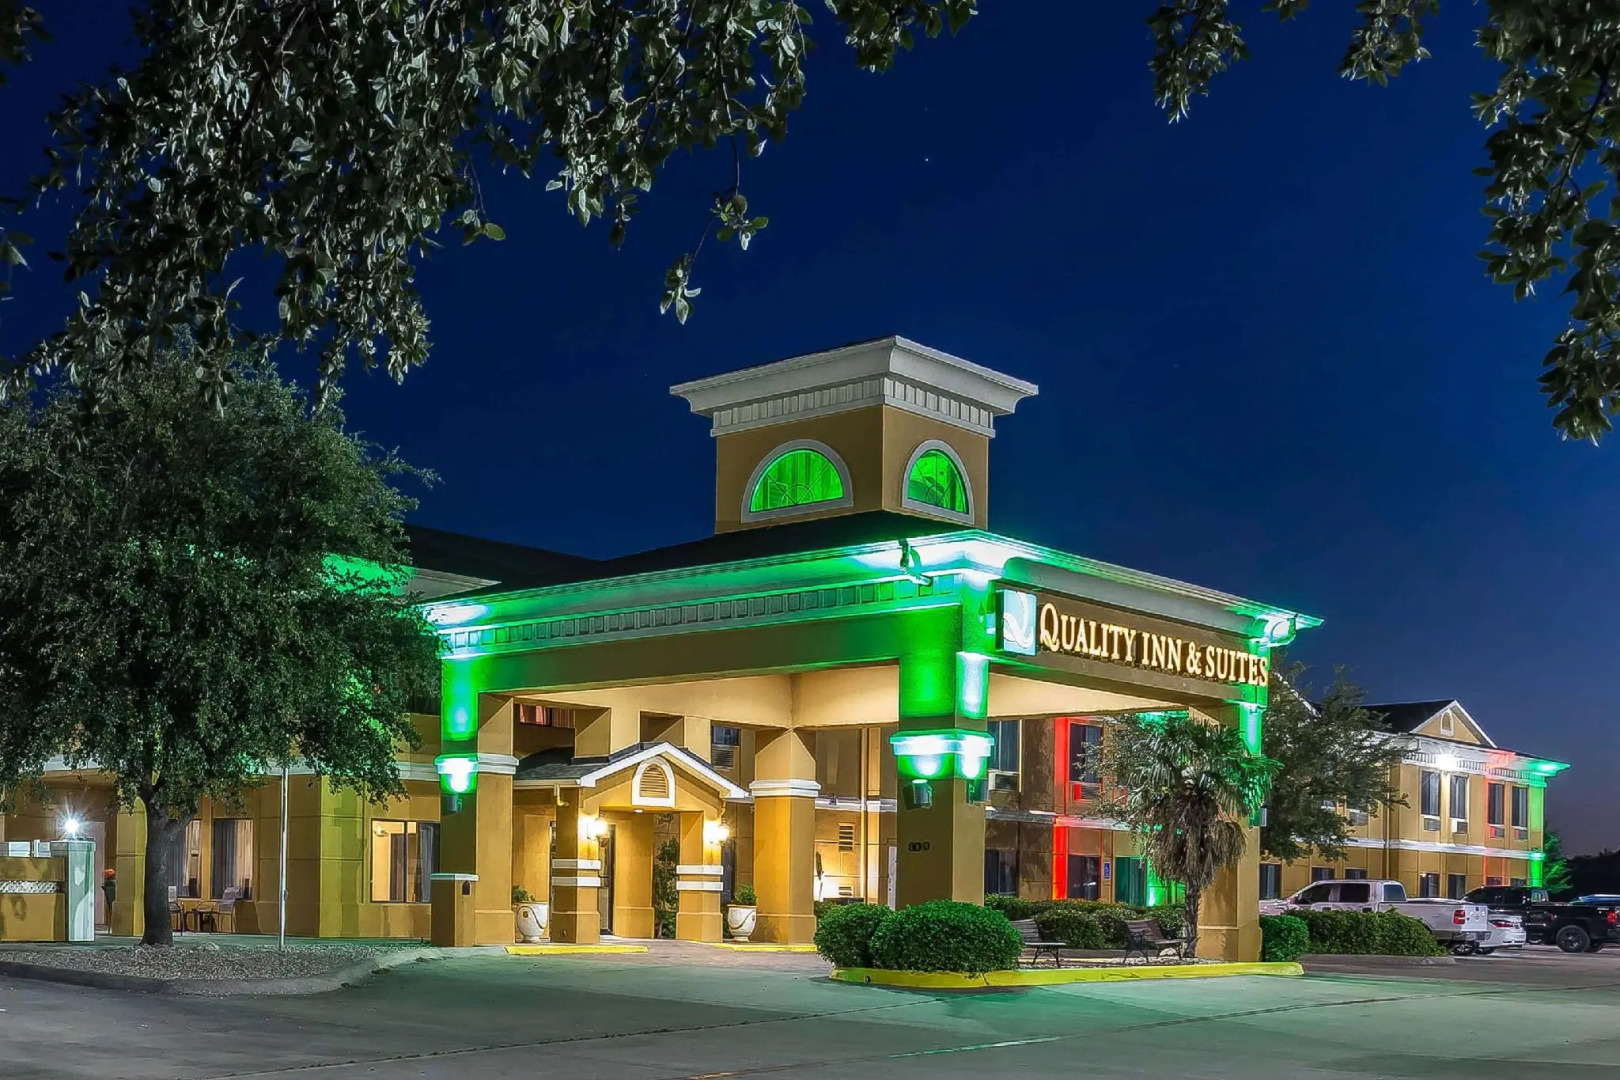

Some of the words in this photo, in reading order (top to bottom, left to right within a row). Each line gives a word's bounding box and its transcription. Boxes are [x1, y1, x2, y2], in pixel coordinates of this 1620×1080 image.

[1040, 603, 1136, 662] QUALITY
[1142, 632, 1181, 671] INN
[1186, 641, 1203, 675] &
[1205, 646, 1268, 687] SUITES
